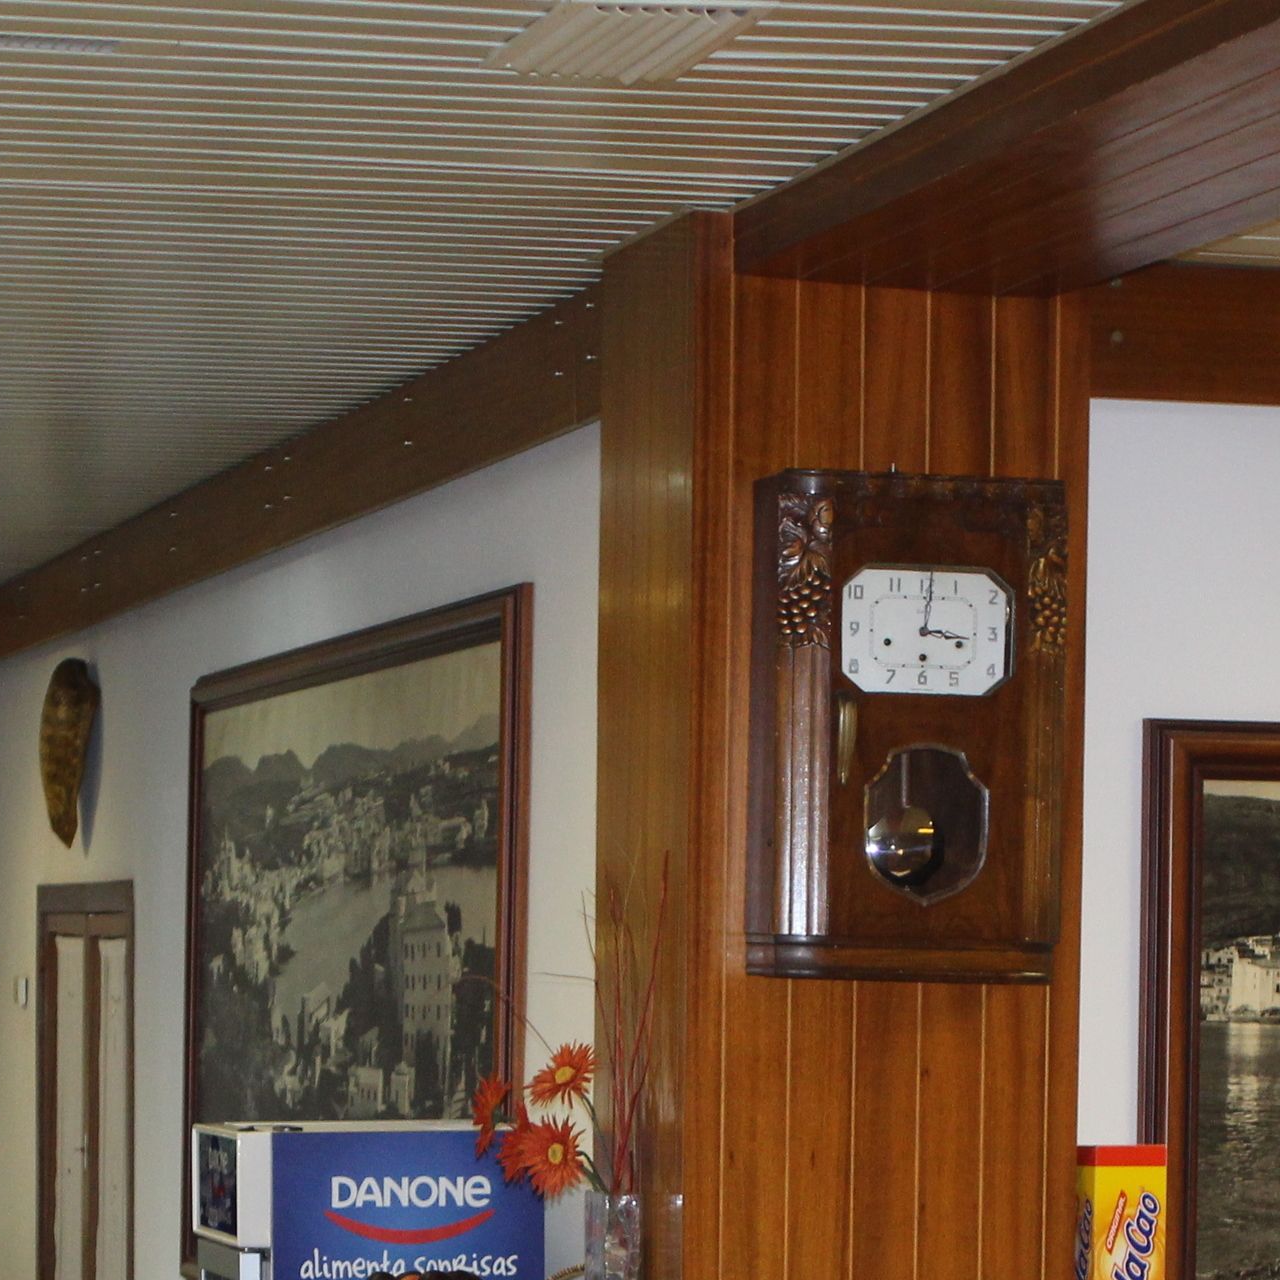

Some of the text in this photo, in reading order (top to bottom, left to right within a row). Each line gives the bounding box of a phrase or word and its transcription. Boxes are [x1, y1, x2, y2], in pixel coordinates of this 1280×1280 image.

[848, 584, 864, 600] 10
[889, 577, 901, 592] 11
[988, 590, 999, 605] 2
[849, 621, 860, 636] 9
[987, 627, 998, 642] 3
[848, 658, 859, 674] 8
[986, 663, 996, 677] 4
[886, 669, 896, 684] 7
[917, 670, 928, 685] 6
[949, 671, 959, 687] 5
